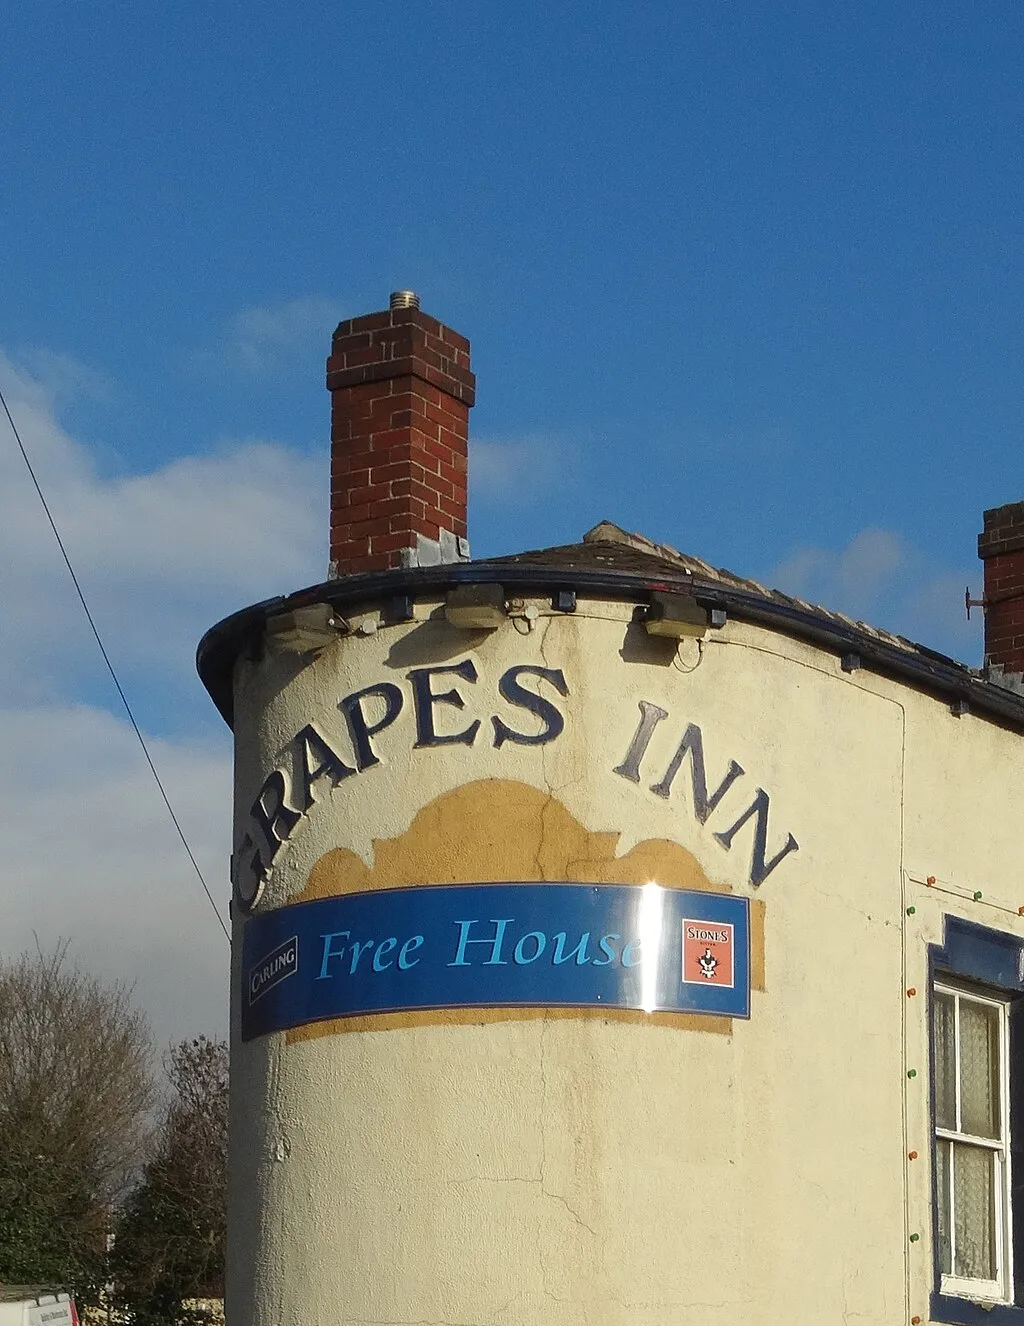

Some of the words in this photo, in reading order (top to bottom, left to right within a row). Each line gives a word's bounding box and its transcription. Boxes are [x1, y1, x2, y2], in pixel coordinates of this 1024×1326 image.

[235, 659, 571, 910] GRAPES
[612, 699, 800, 889] INN
[314, 930, 425, 981] Free
[687, 926, 729, 943] STONES
[251, 947, 295, 993] CARLING
